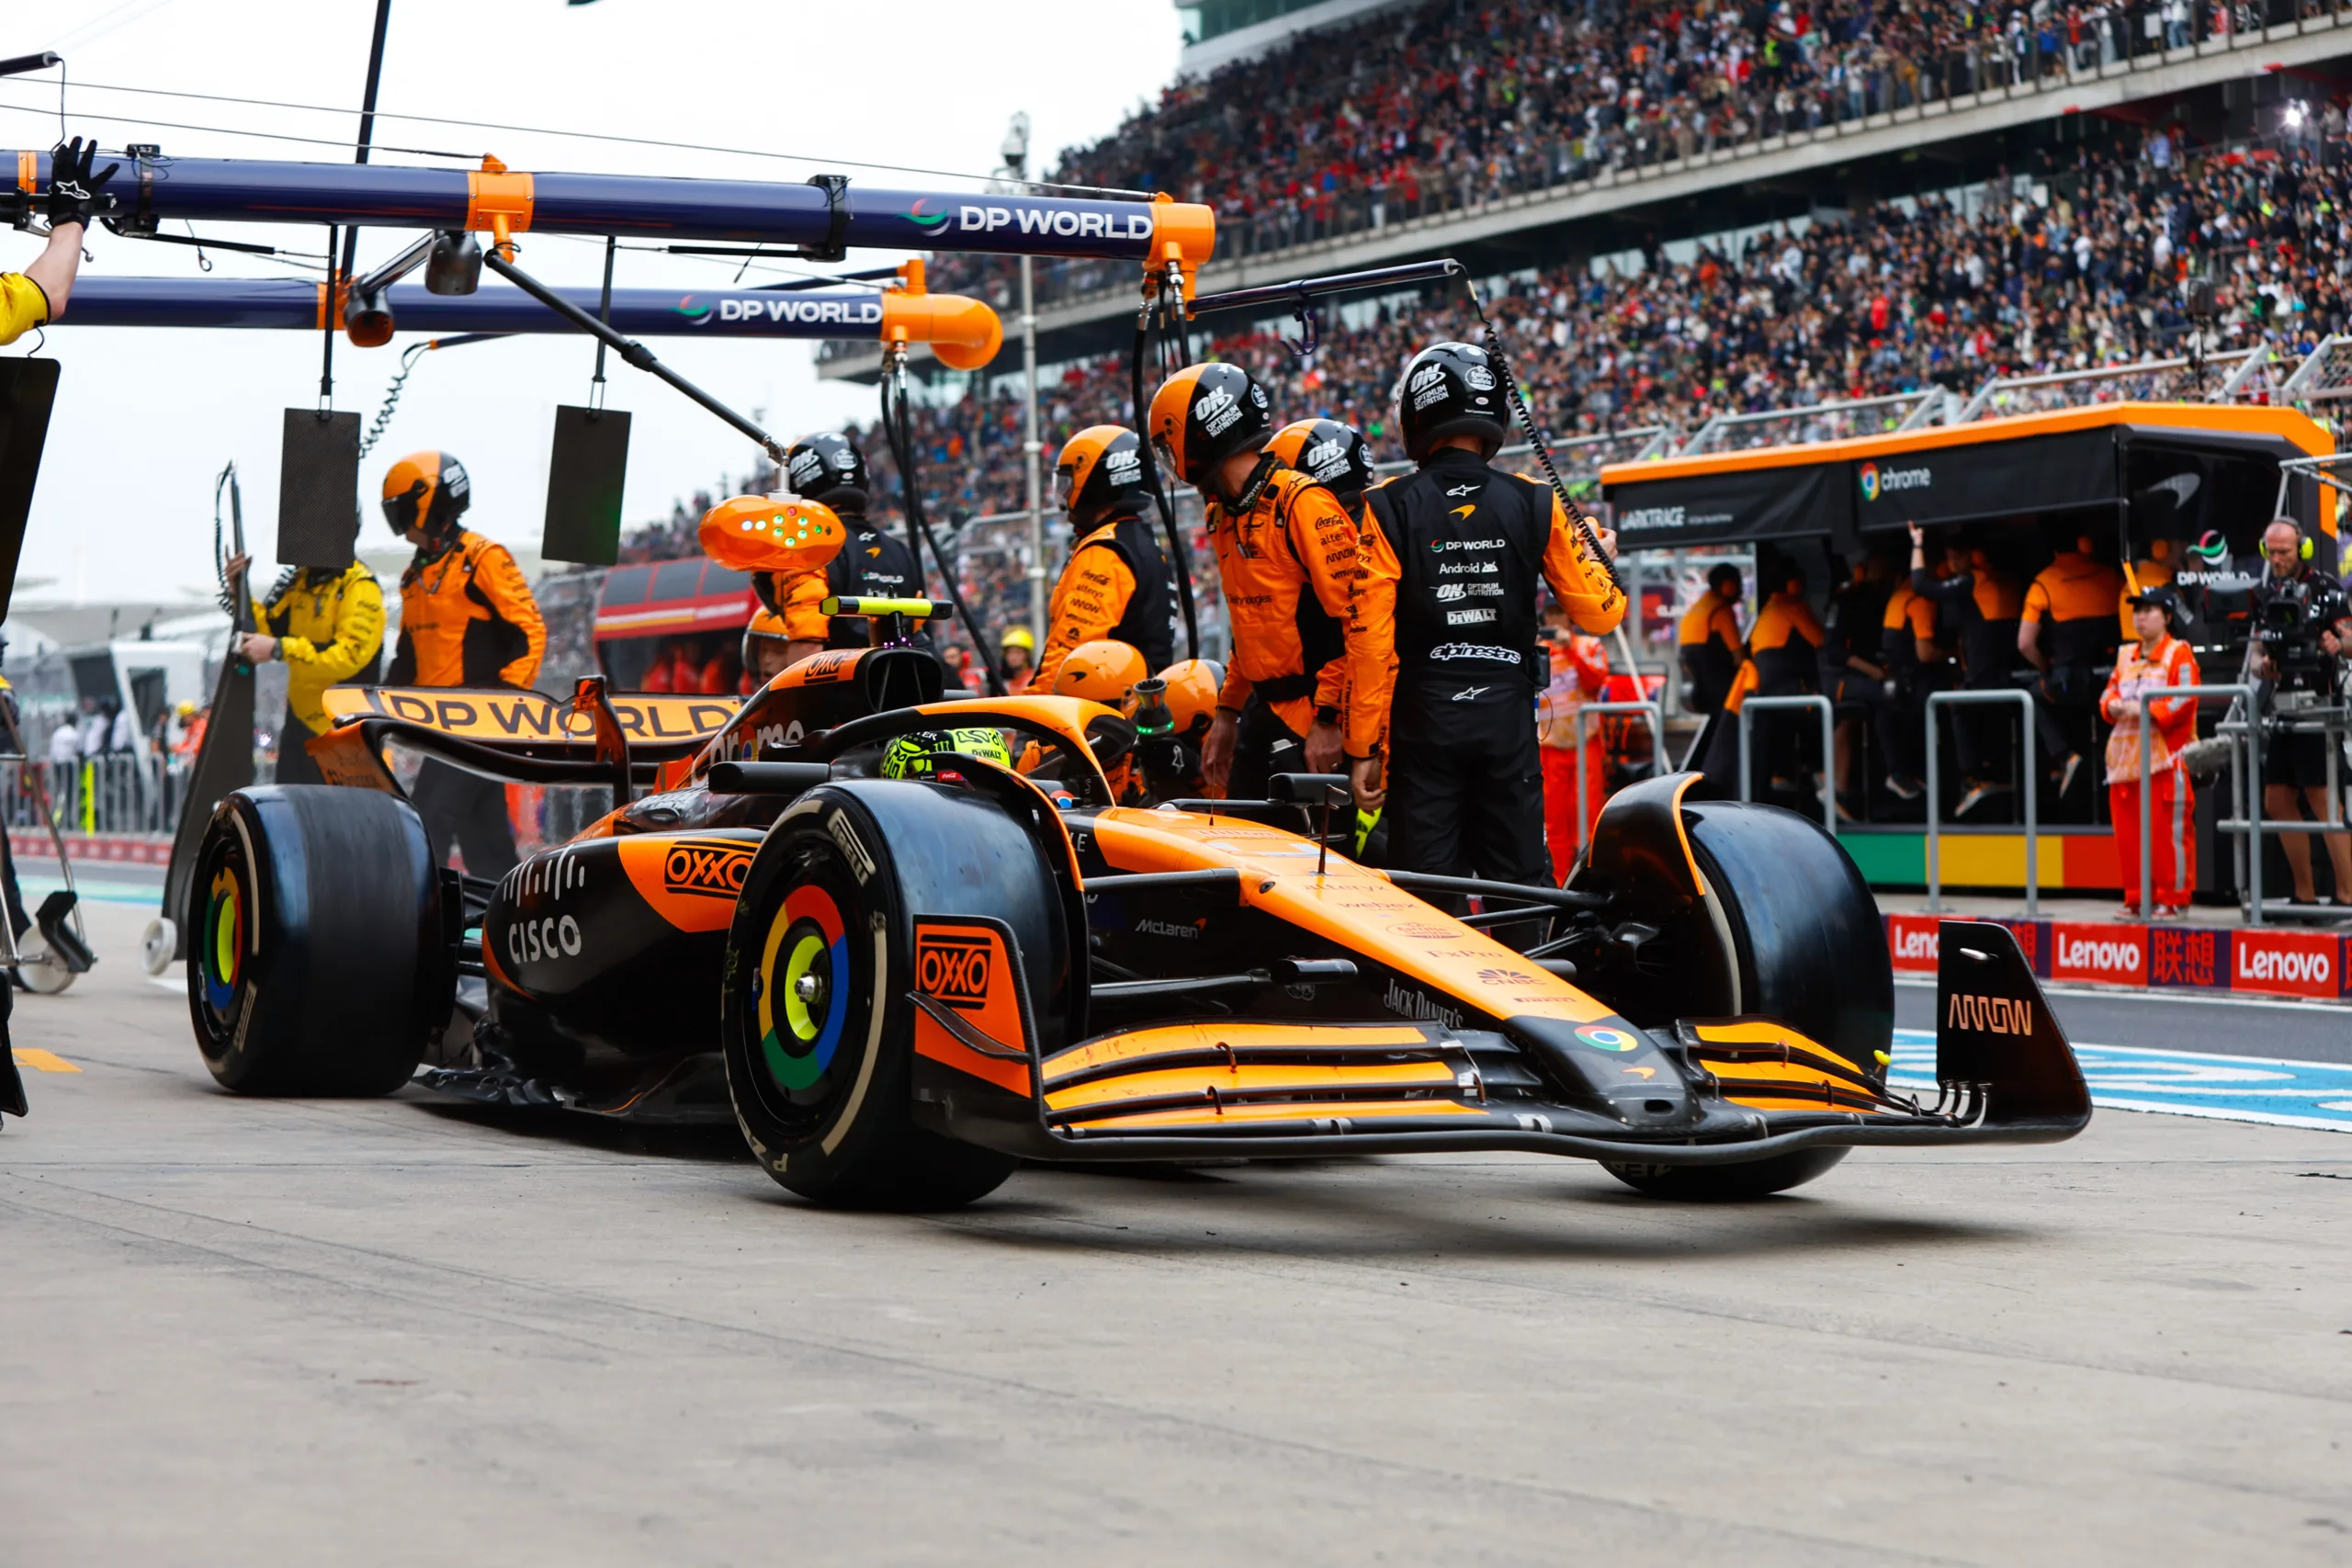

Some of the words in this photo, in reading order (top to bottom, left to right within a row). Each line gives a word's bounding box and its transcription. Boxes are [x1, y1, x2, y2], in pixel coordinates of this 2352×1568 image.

[960, 206, 1011, 231] DP
[1015, 209, 1153, 240] WORLD
[719, 299, 763, 321] DP
[766, 300, 882, 323] WORLD
[1194, 386, 1229, 421] ON
[1413, 384, 1447, 404] OPTIMUM
[1415, 391, 1450, 412] NUTRITION
[1205, 404, 1240, 433] OPTIMUM
[1209, 412, 1244, 437] NUTRITION
[1106, 449, 1136, 469] ON
[1307, 438, 1338, 467] ON
[1314, 458, 1349, 478] OPTIMUM
[1881, 468, 1930, 491] chrome
[1464, 539, 1506, 550] WORLD
[1438, 562, 1481, 574] Android
[2177, 571, 2198, 586] DP
[1436, 583, 1464, 599] ON
[1467, 582, 1499, 591] OPTIMUM
[806, 651, 844, 678] OXXO
[1430, 643, 1521, 663] alpinestars
[391, 695, 477, 730] DP
[488, 700, 734, 737] WORLD
[667, 850, 753, 887] OXXO
[1304, 884, 1389, 898] alteryx
[1337, 901, 1419, 910] webex
[508, 915, 582, 964] CISCO
[1135, 919, 1198, 939] McLaren
[2058, 932, 2140, 972] Lenovo
[2153, 930, 2216, 987] 联想
[2239, 942, 2330, 984] Lenovo
[922, 950, 988, 994] OXXO
[1948, 993, 2032, 1036] ARROW
